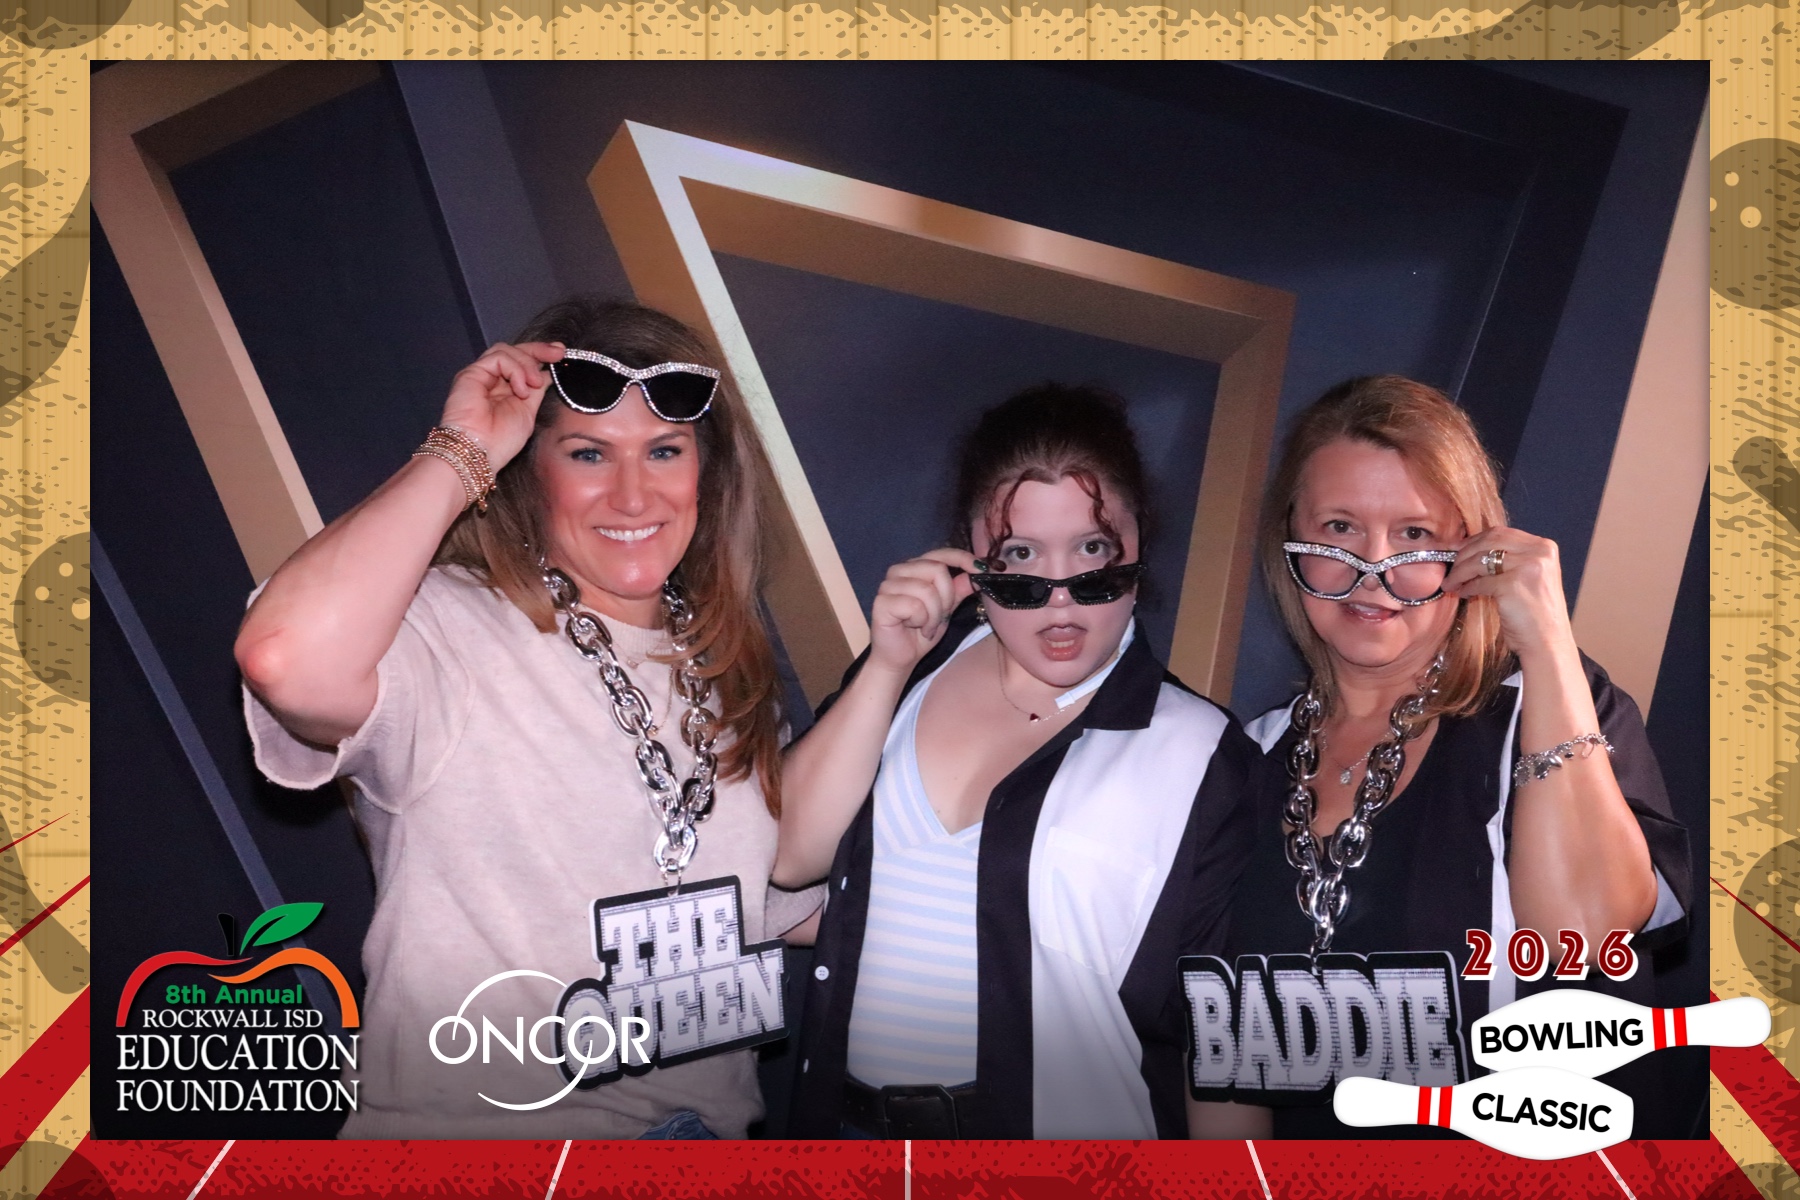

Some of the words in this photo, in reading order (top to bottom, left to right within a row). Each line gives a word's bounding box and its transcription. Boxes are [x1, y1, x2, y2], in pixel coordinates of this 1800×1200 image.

[600, 885, 742, 987] THE
[560, 948, 785, 1079] QUEEN
[1183, 967, 1458, 1090] BADDIE
